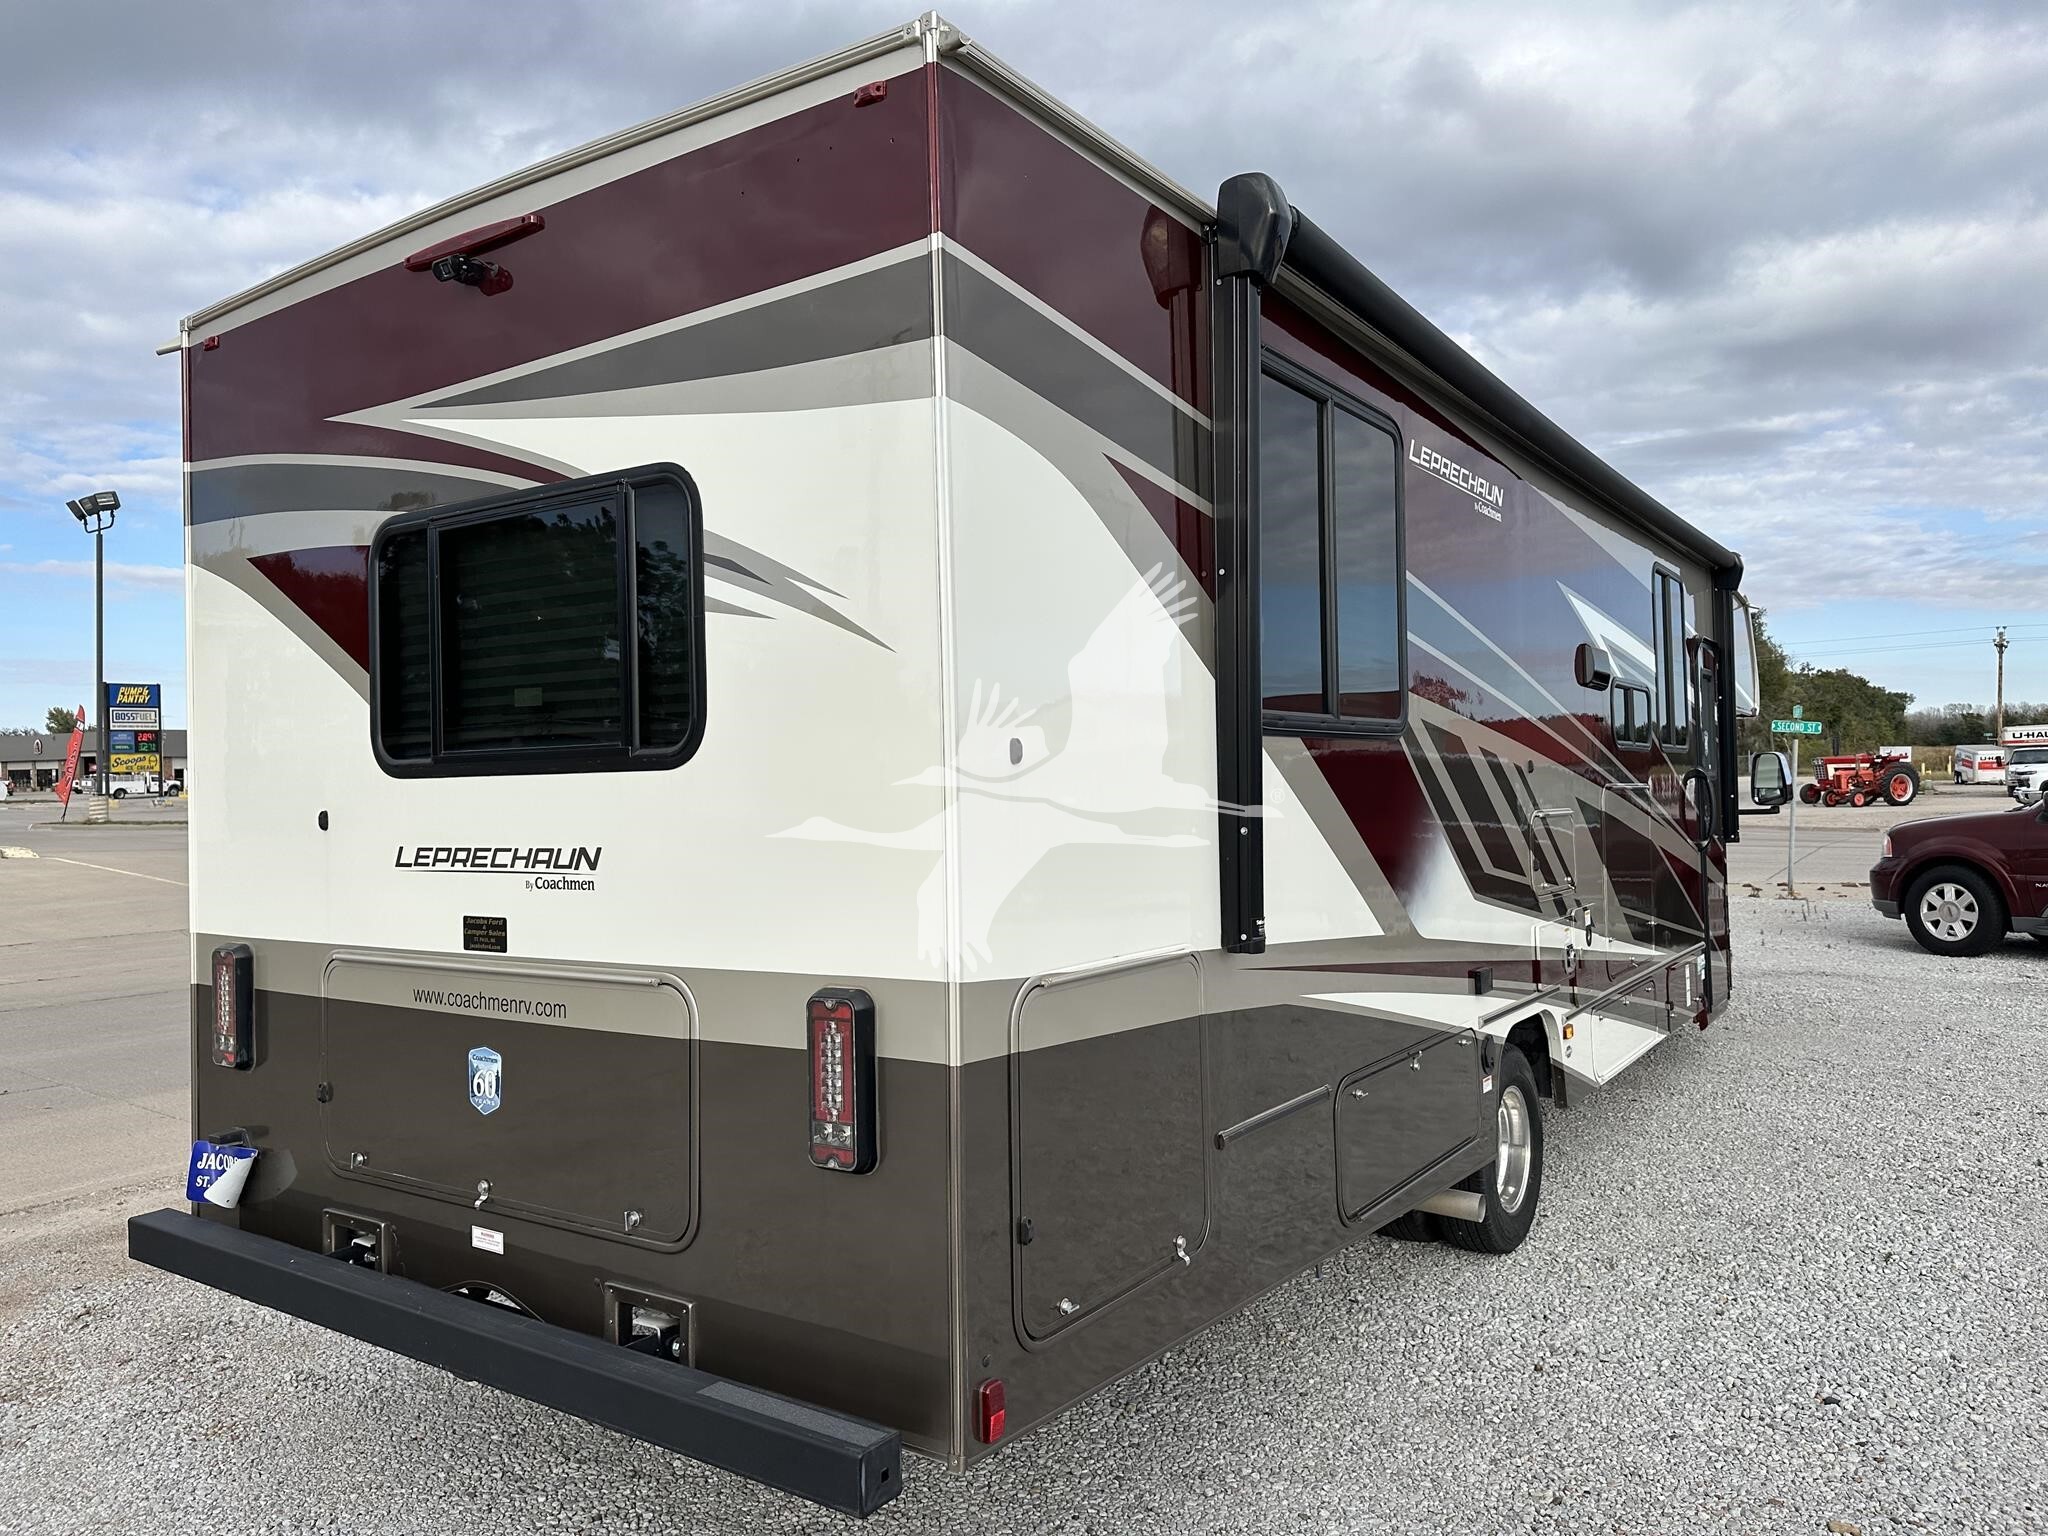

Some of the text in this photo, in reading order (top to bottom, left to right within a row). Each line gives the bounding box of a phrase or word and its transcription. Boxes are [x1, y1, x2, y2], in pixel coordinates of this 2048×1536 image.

[1408, 439, 1504, 507] LEPRECHAUN
[119, 687, 143, 695] PUMP
[116, 695, 151, 703] PANTRY
[1777, 722, 1804, 731] SECOND
[112, 756, 146, 768] Scoops
[394, 846, 602, 871] LEPRECHAUN
[525, 876, 596, 892] By Coachmen
[465, 928, 488, 936] Camper
[413, 988, 567, 1019] www.coachmenrv.com
[473, 1069, 497, 1099] 60
[475, 1098, 495, 1106] YEARS
[195, 1175, 212, 1188] ST.
